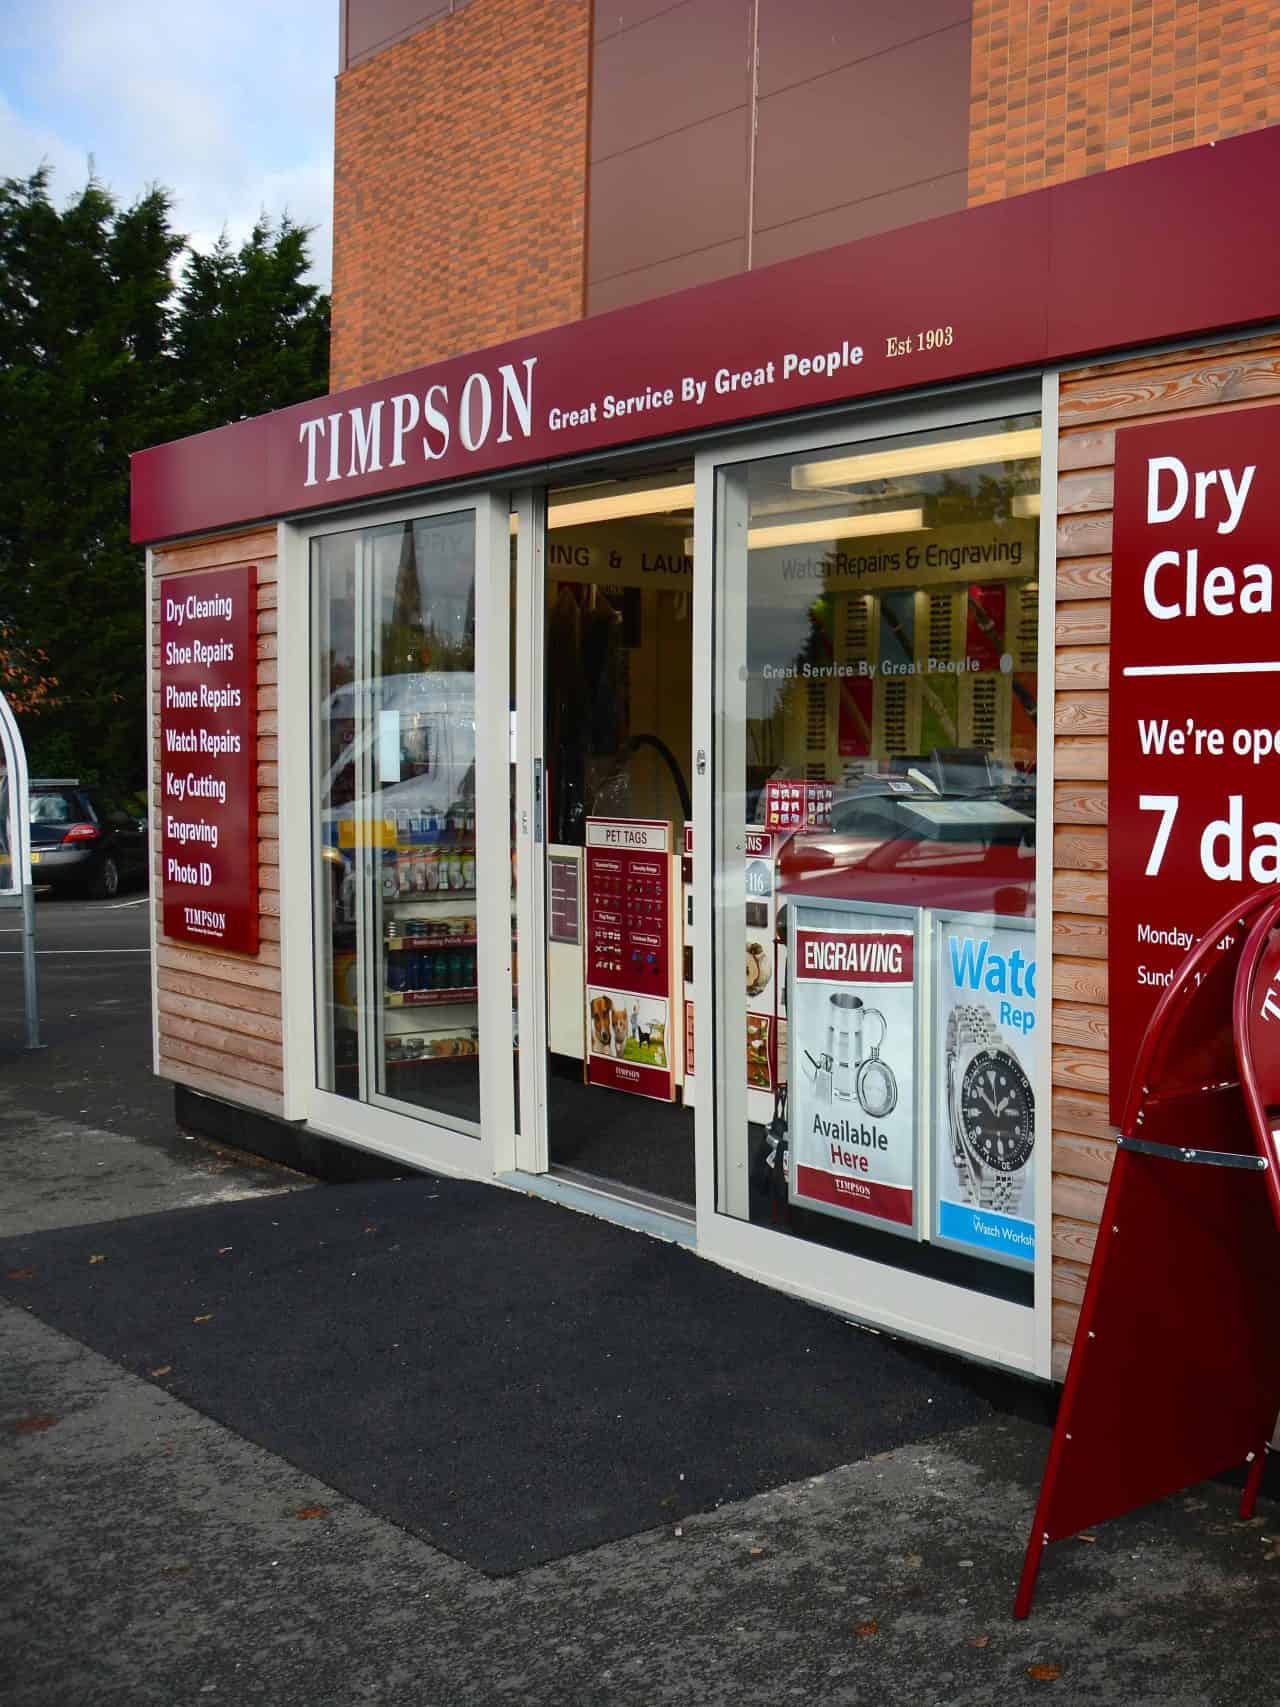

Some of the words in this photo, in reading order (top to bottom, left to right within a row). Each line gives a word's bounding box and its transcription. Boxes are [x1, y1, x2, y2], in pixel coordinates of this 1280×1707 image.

[299, 357, 538, 486] TIMPSON
[549, 405, 597, 431] Great
[602, 386, 674, 420] Service
[682, 378, 706, 405] By
[715, 362, 775, 395] Great
[783, 341, 864, 382] People
[886, 336, 913, 358] Est
[917, 327, 954, 353] 1903
[1146, 455, 1257, 535] Dry
[549, 544, 590, 566] ING
[836, 552, 900, 577] Repairs
[906, 545, 921, 568] &
[926, 538, 1023, 569] Engraving
[166, 599, 185, 626] Dry
[186, 595, 232, 621] Cleaning
[166, 642, 192, 665] Shoe
[194, 638, 234, 667] Repairs
[763, 664, 798, 680] Great
[803, 661, 853, 679] Service
[859, 660, 876, 679] By
[881, 658, 921, 676] Great
[927, 656, 980, 674] People
[166, 685, 198, 709] Phone
[200, 684, 241, 713] Repairs
[166, 729, 198, 753] Watch
[200, 729, 241, 758] Repairs
[166, 773, 186, 801] Key
[187, 773, 226, 803] Cutting
[167, 816, 218, 848] Engraving
[605, 829, 621, 843] PET
[623, 829, 648, 845] TAGS
[1139, 795, 1179, 876] 7
[168, 859, 198, 885] Photo
[200, 863, 212, 887] ID
[184, 907, 225, 930] TIMPSON
[1137, 923, 1194, 951] Monday
[804, 940, 903, 975] ENGRAVING
[1137, 965, 1174, 987] Sund
[1000, 1001, 1035, 1035] Rep
[813, 1113, 888, 1151] Available
[831, 1143, 869, 1173] Here
[835, 1179, 871, 1195] TIMPSON
[973, 1221, 1000, 1237] Watch
